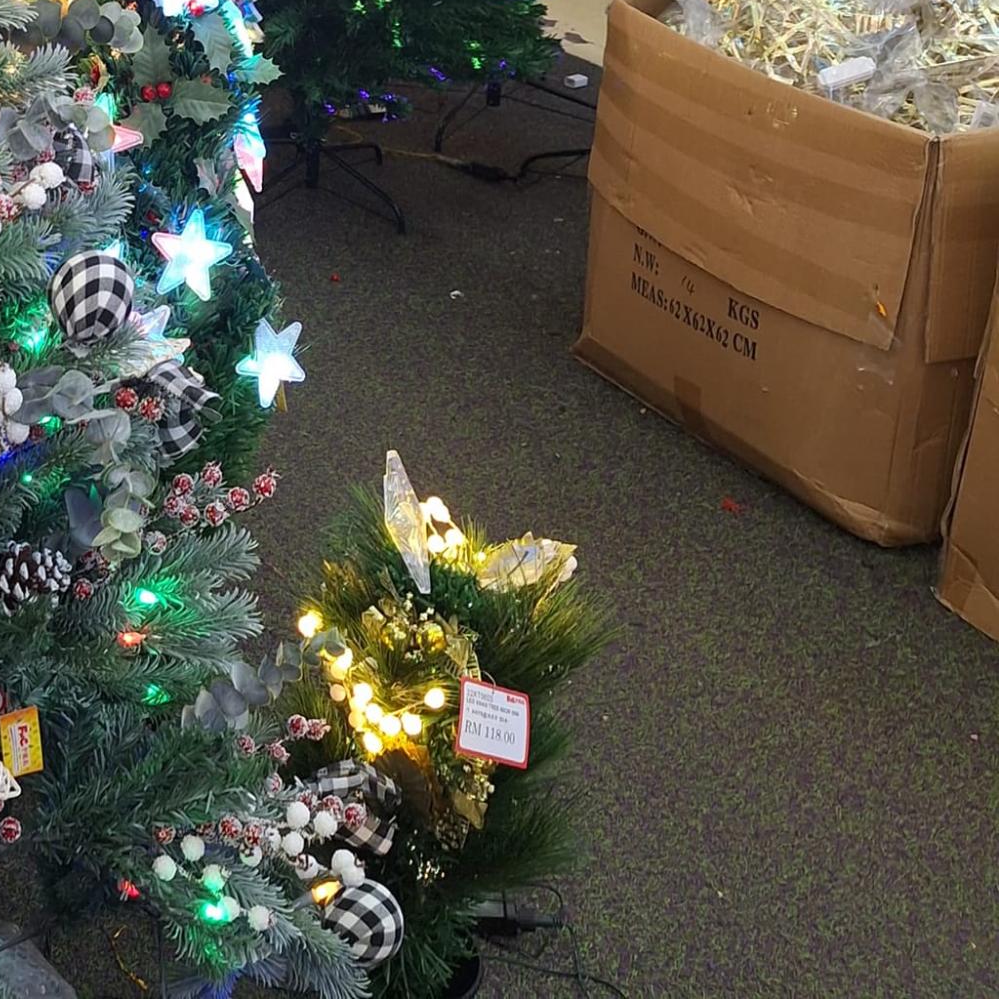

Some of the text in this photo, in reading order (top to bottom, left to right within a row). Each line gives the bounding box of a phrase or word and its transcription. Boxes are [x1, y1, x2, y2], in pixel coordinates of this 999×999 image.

[633, 242, 659, 276] N.W:
[727, 296, 760, 330] KGS
[732, 332, 758, 361] CM
[465, 719, 516, 744] RM 118.00
